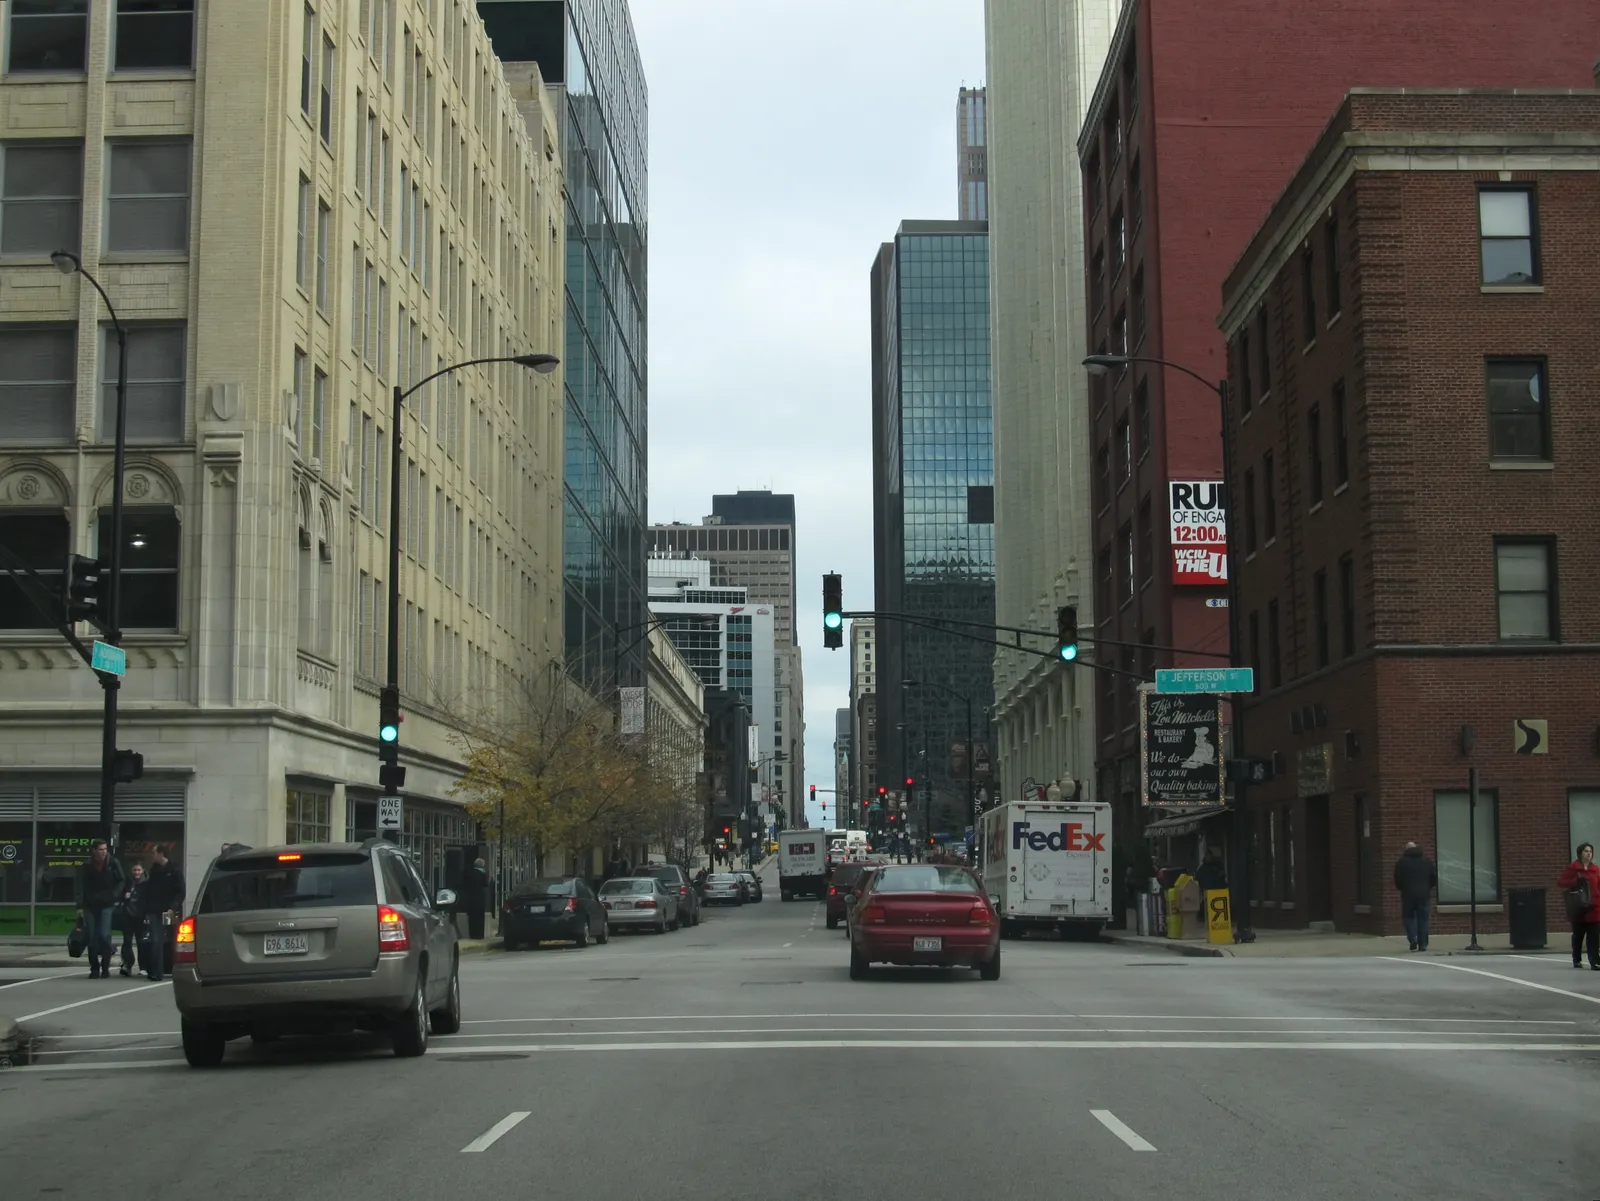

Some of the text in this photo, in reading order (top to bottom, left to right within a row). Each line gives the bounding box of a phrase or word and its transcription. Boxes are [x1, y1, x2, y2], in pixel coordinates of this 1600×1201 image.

[1173, 510, 1226, 523] OF ENGA
[1174, 549, 1207, 559] WCIU
[1176, 560, 1209, 573] THE
[1171, 672, 1226, 682] JEFFERSON
[621, 691, 644, 700] WEST
[622, 700, 643, 709] LOOP
[1148, 697, 1185, 716] This is
[1151, 710, 1171, 726] Lou
[1154, 728, 1187, 737] RESTAURANT
[1157, 735, 1183, 744] & BAKERY
[1150, 751, 1180, 763] We do
[1150, 769, 1188, 777] our own
[1150, 779, 1218, 794] Quality baking
[381, 800, 400, 808] ONE
[381, 809, 400, 817] WAY
[1013, 822, 1106, 851] FedEx
[266, 938, 306, 950] G96 8614
